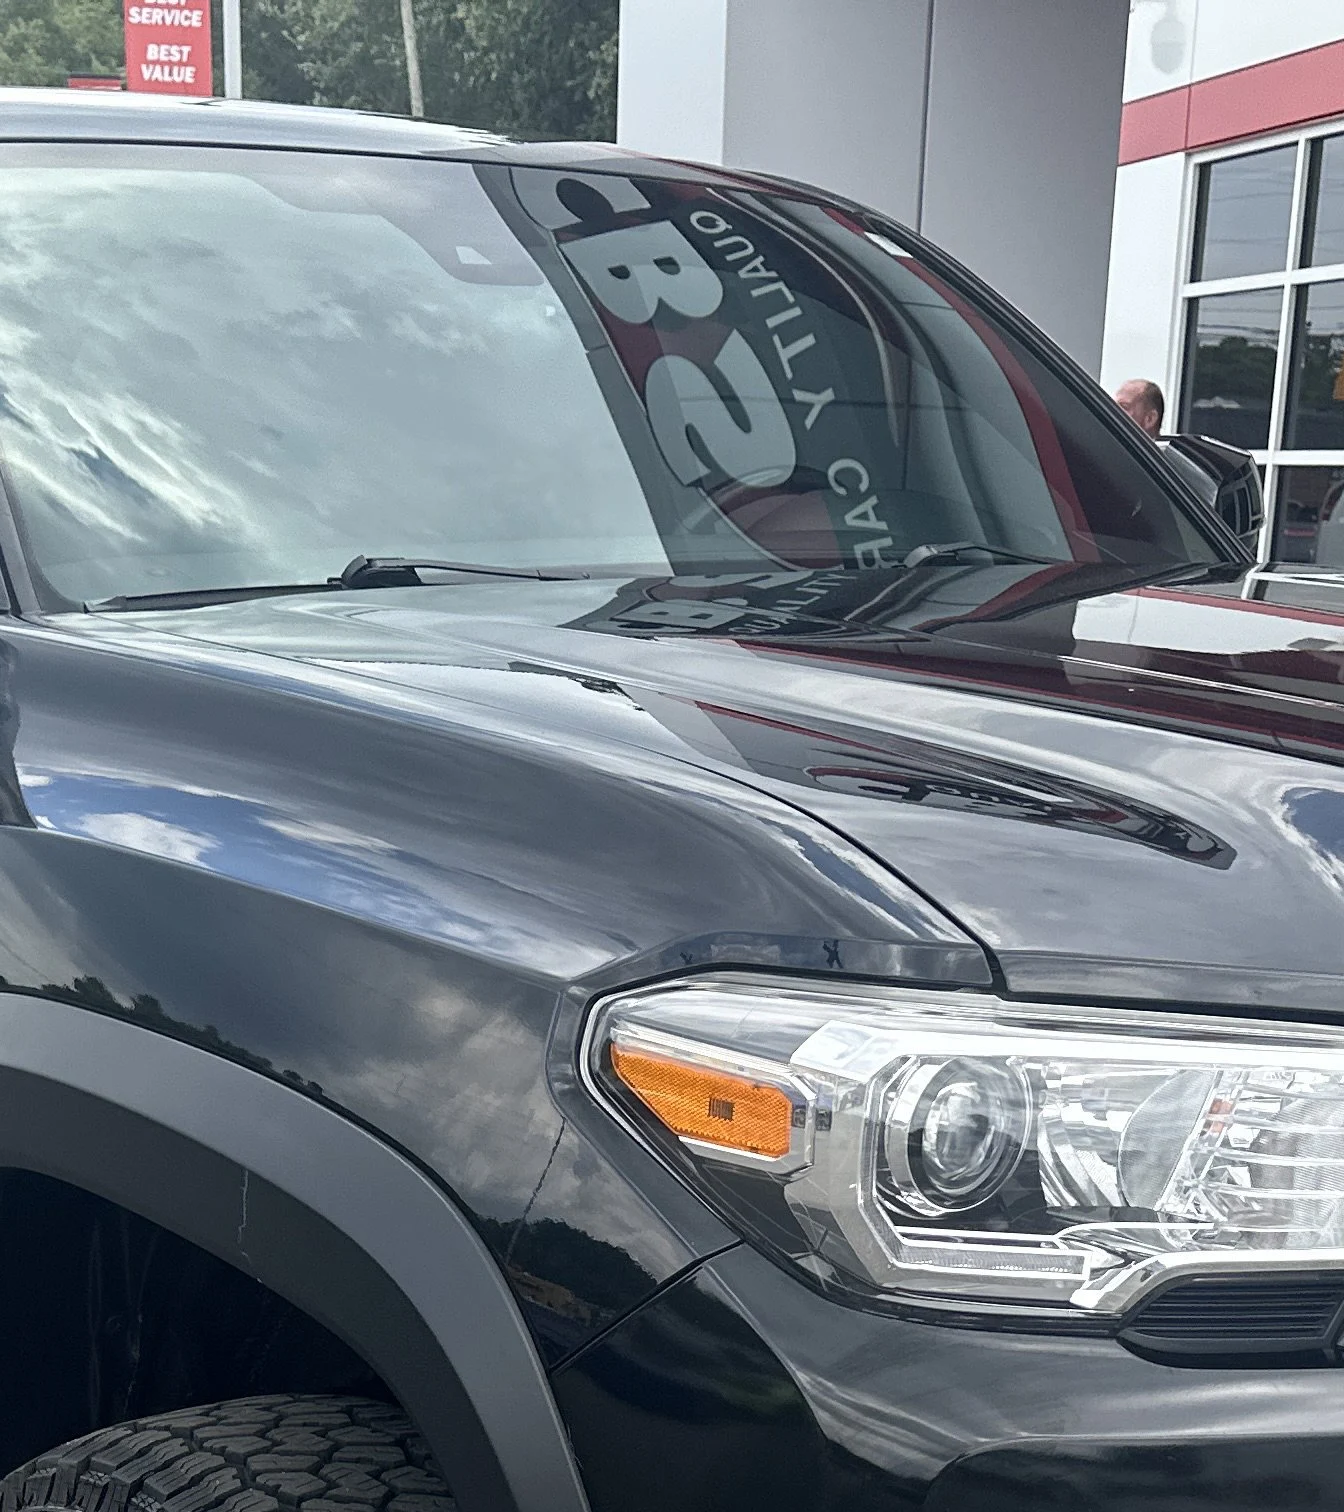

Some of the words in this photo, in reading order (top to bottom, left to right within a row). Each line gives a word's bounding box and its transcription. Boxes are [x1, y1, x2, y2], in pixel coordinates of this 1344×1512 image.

[128, 6, 204, 27] SERVICE
[146, 43, 192, 63] BEST
[140, 63, 197, 84] VALUE
